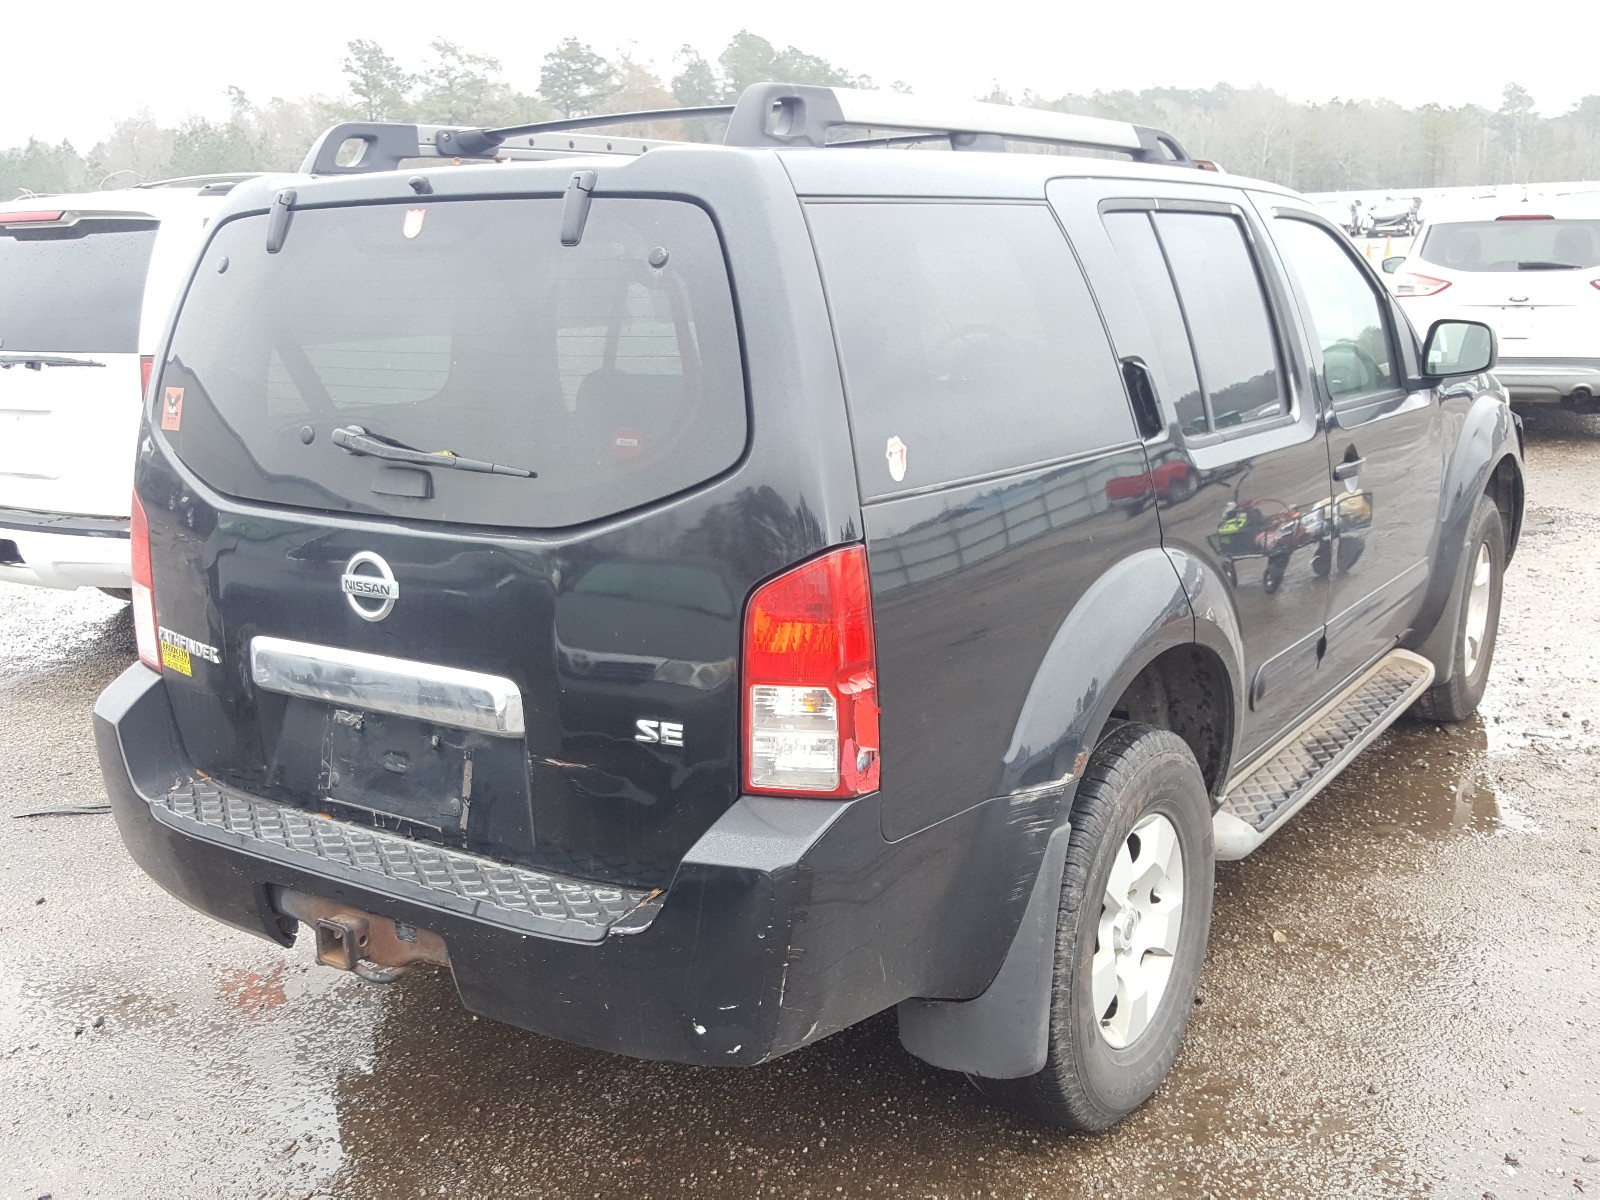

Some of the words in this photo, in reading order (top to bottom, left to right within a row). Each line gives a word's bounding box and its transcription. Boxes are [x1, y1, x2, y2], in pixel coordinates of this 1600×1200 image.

[345, 579, 390, 596] NISSAN
[159, 625, 221, 664] PATHFINDER
[635, 719, 684, 747] SE
